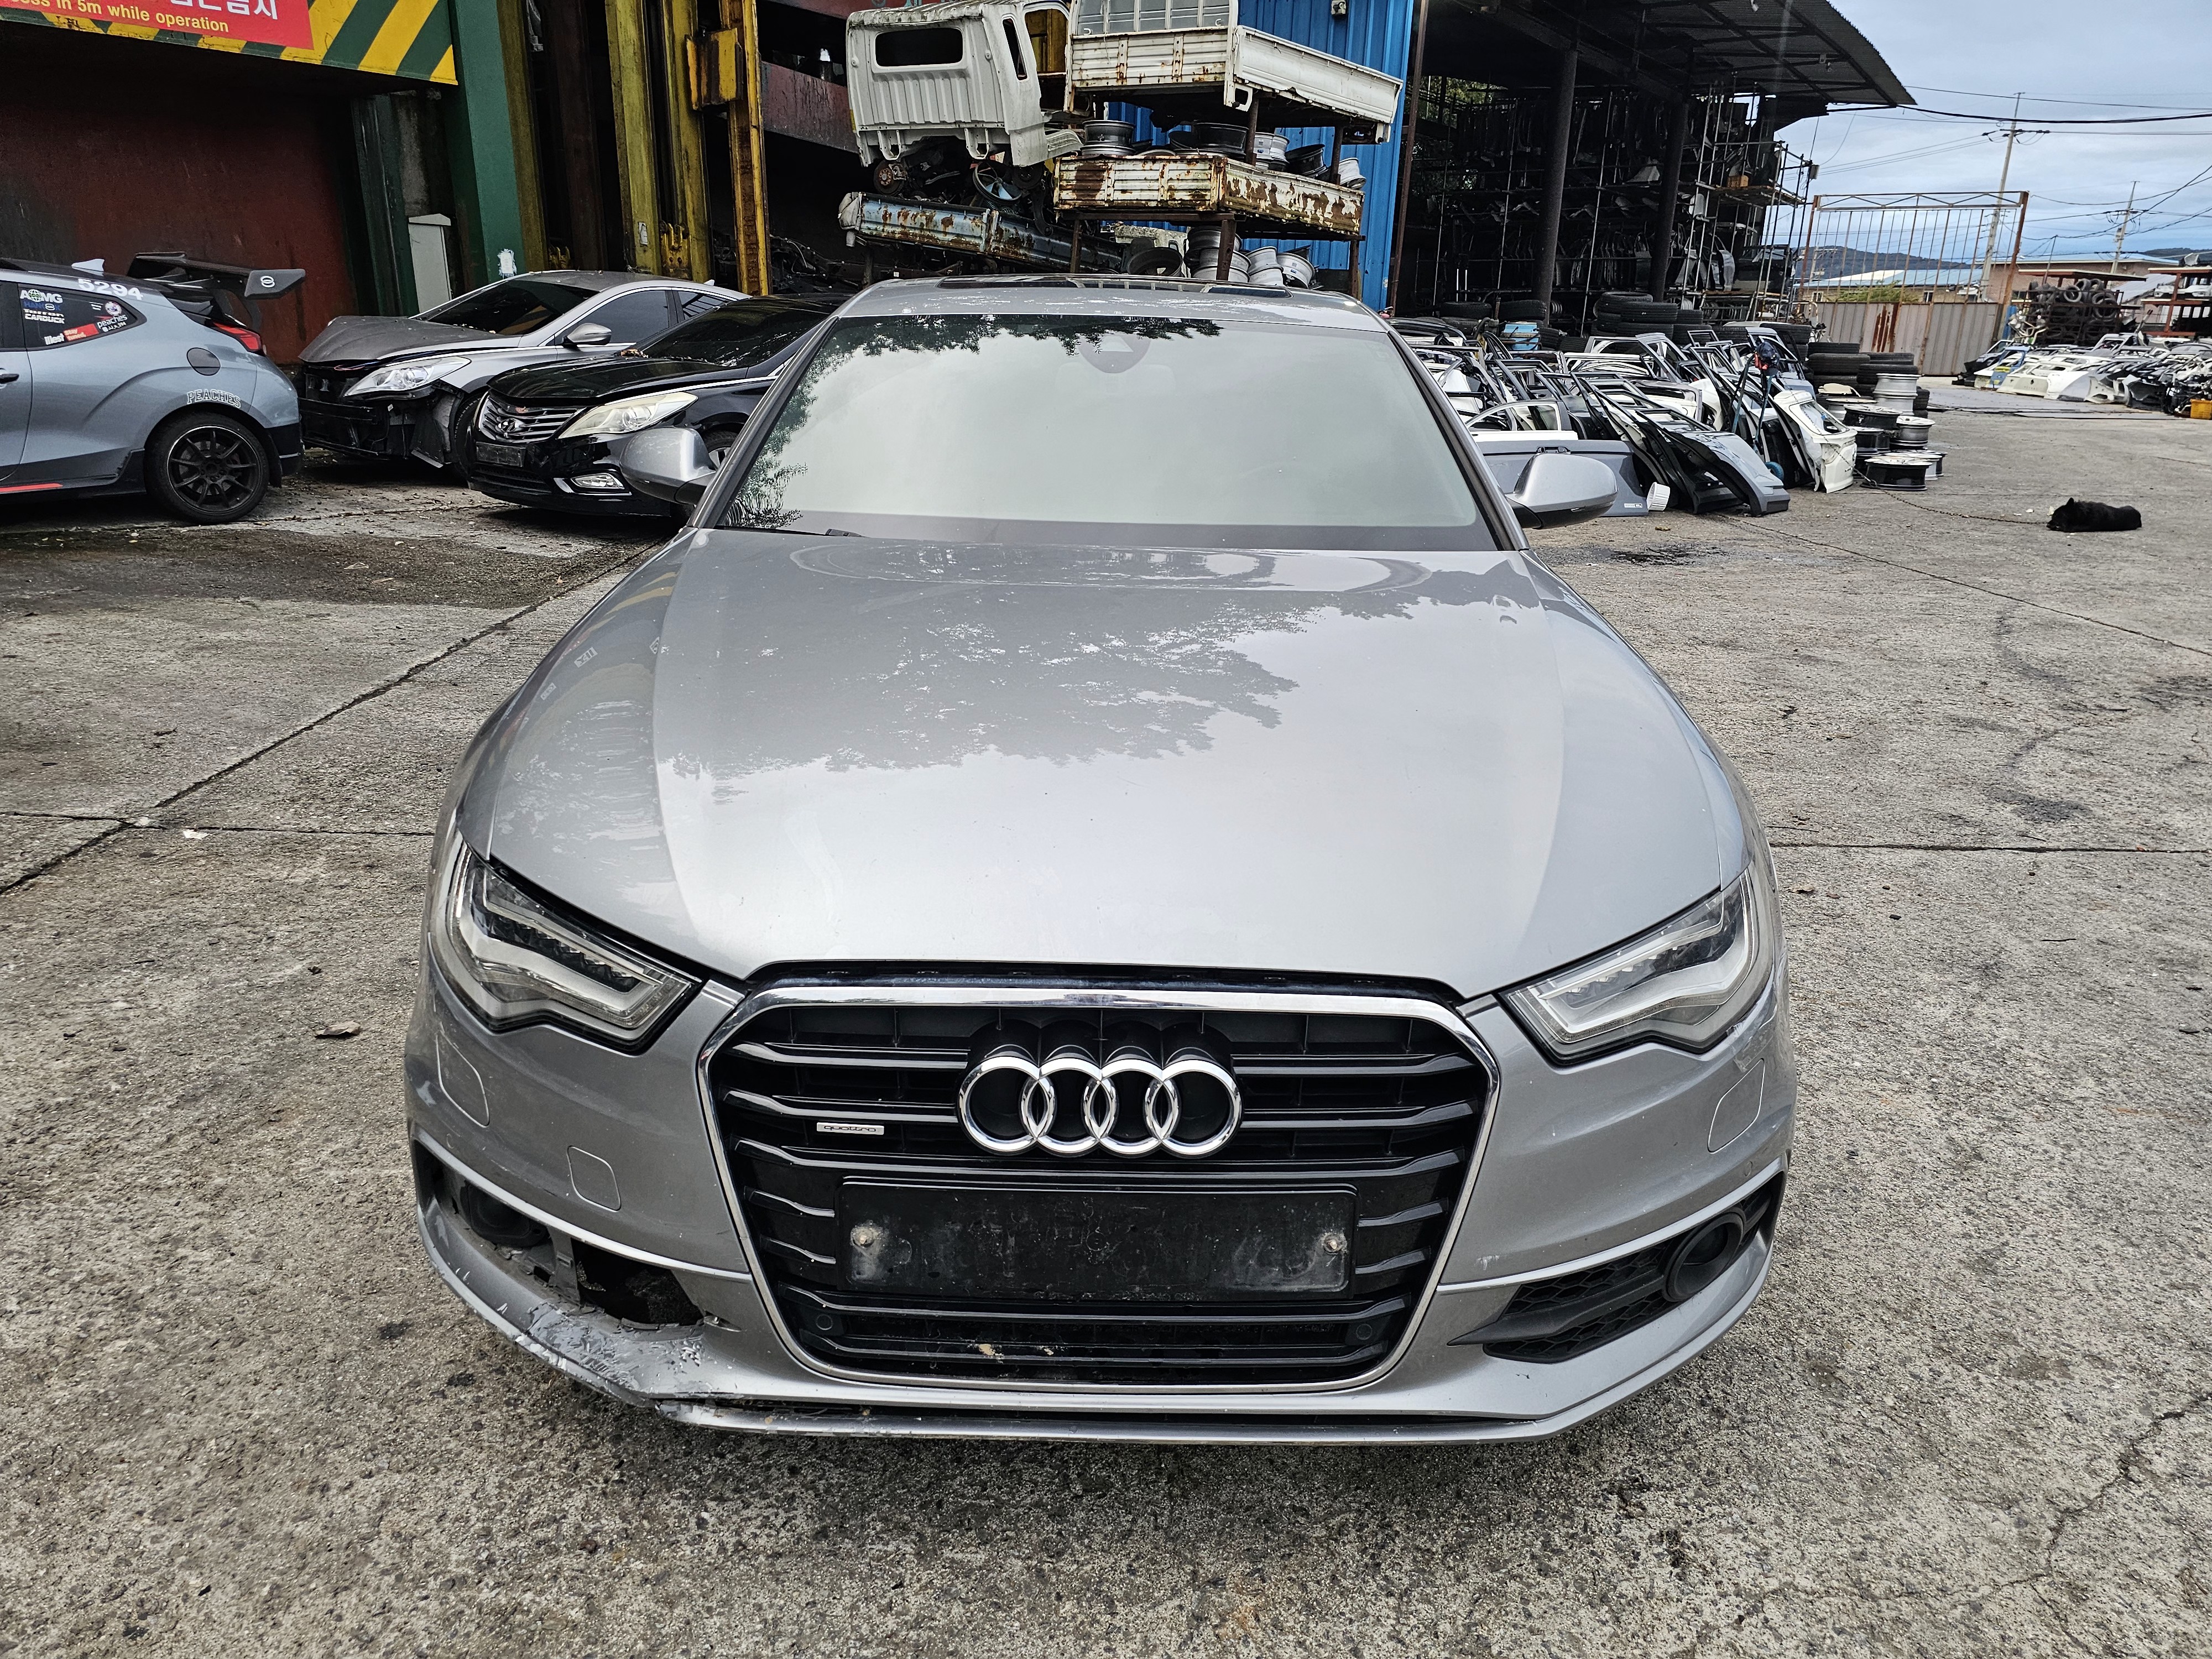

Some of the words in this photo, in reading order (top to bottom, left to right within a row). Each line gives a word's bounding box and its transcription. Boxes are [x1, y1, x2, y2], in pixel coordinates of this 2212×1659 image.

[78, 0, 102, 14] 5m
[107, 4, 150, 21] while
[156, 12, 228, 32] operation
[78, 278, 144, 300] 5294
[97, 315, 128, 329] peaches
[187, 389, 241, 408] PEACHES
